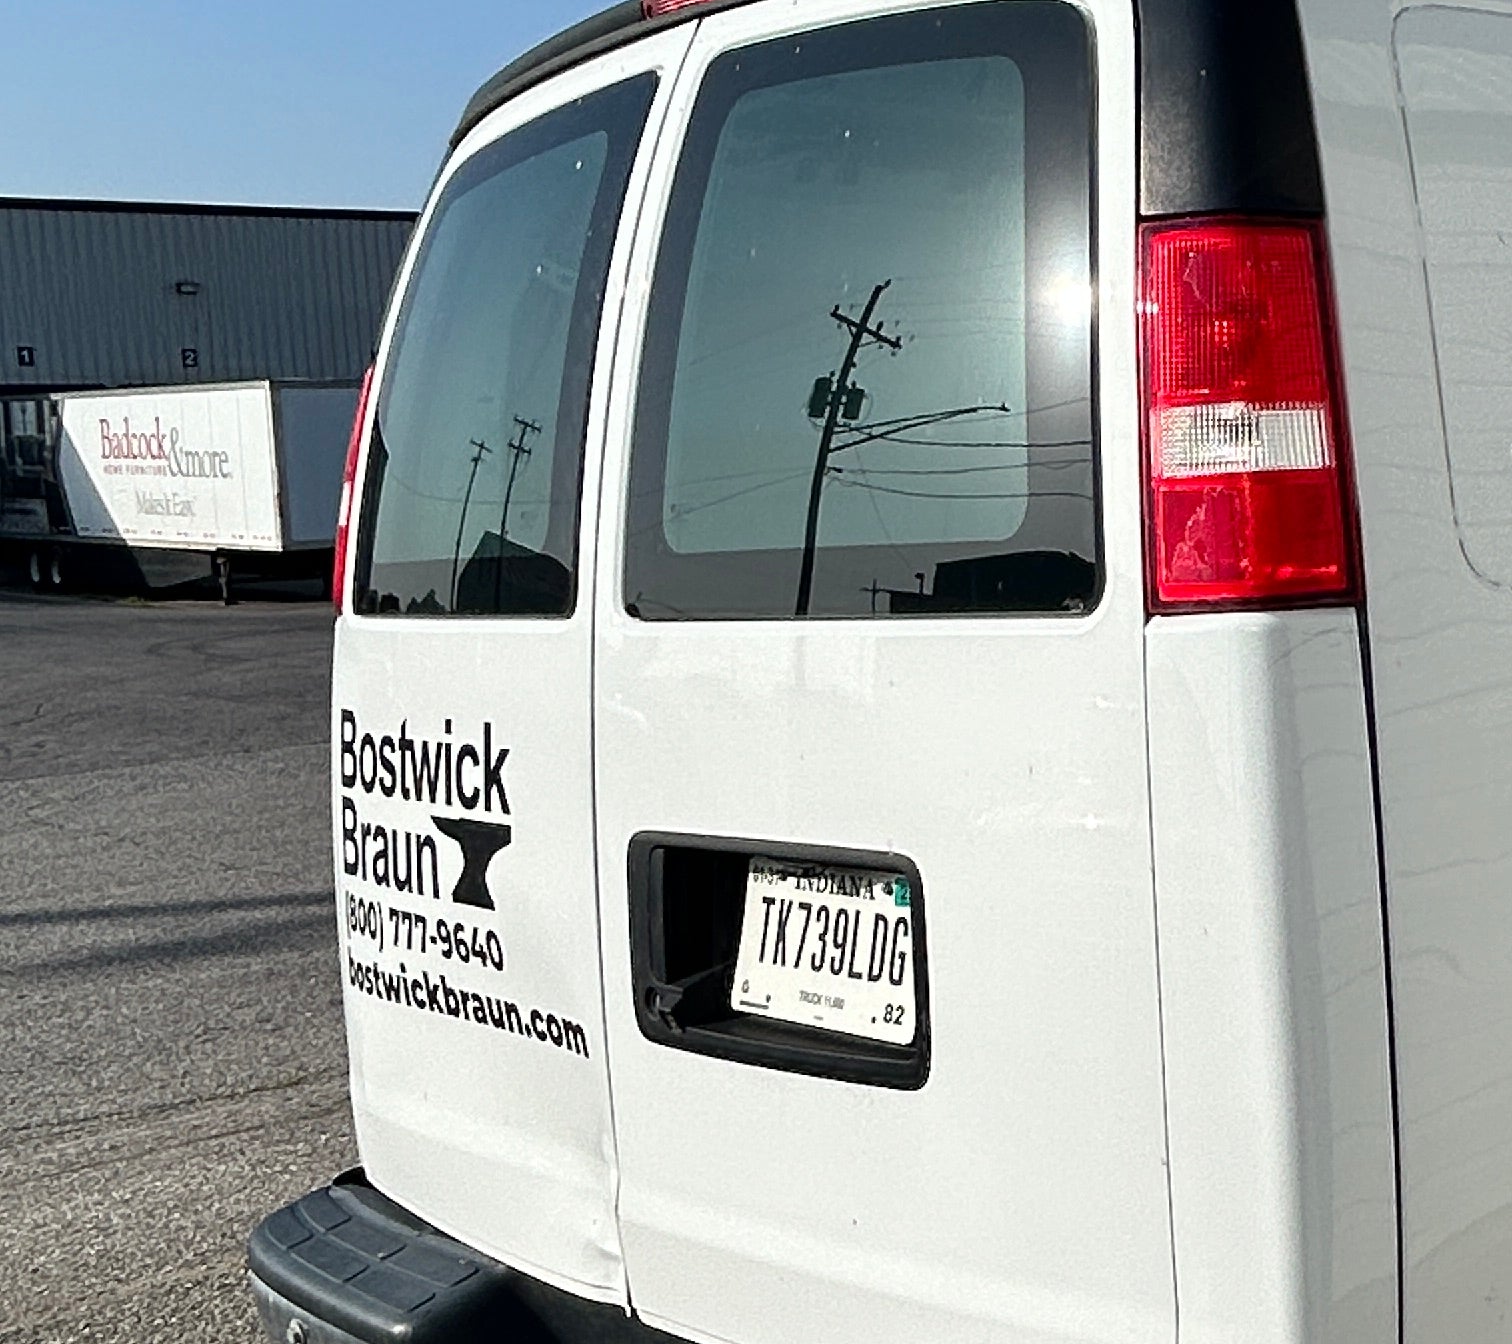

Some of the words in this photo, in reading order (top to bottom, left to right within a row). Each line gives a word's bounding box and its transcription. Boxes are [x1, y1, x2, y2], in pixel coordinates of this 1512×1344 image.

[99, 416, 168, 460] Badcock
[341, 708, 511, 816] Bostwick
[342, 795, 440, 900] Braun
[345, 890, 384, 953] (800)
[389, 907, 503, 972] 777-9640
[758, 896, 909, 986] TK739LDG
[348, 946, 590, 1059] bostwickbraun.com
